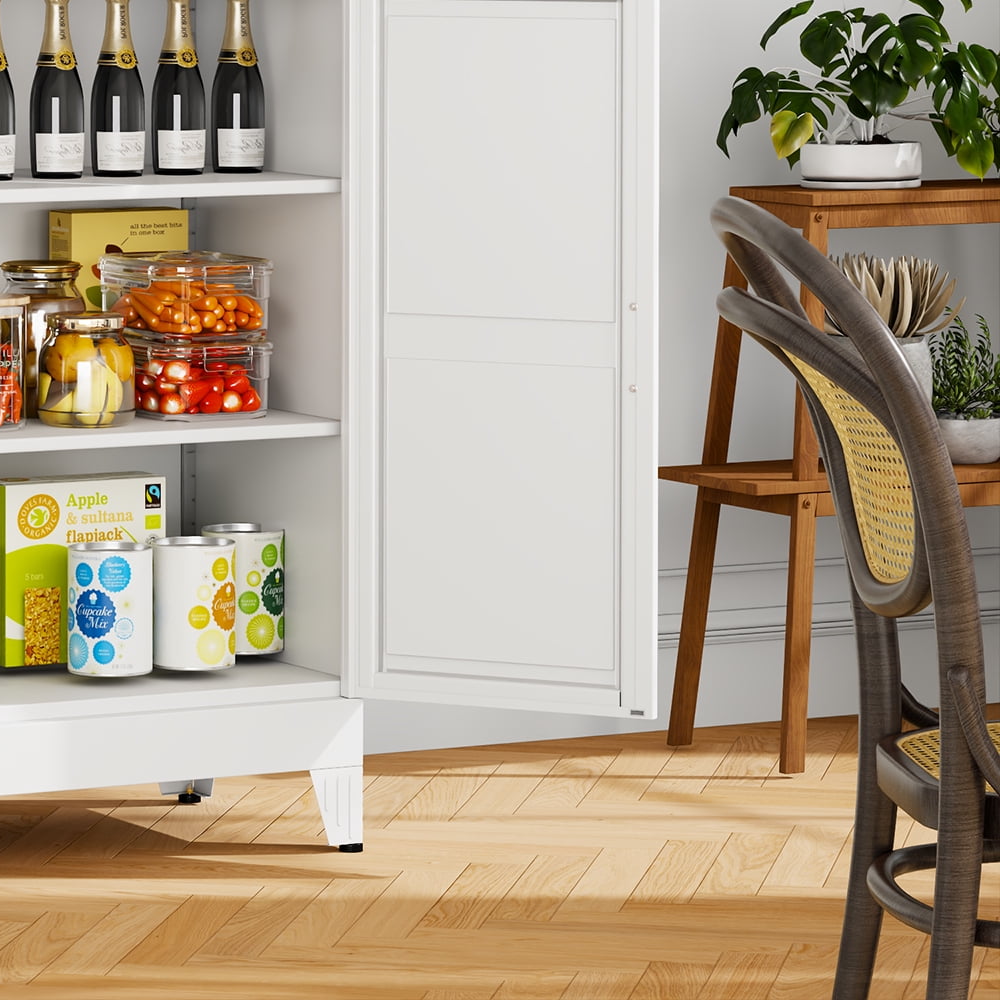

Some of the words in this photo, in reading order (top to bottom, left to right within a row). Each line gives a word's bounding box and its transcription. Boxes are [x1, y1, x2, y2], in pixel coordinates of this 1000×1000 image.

[66, 492, 108, 509] Apple
[66, 511, 78, 525] &
[81, 510, 134, 524] sultana
[66, 527, 123, 543] flapjack
[77, 603, 113, 618] Cupcake
[85, 617, 109, 629] Mix
